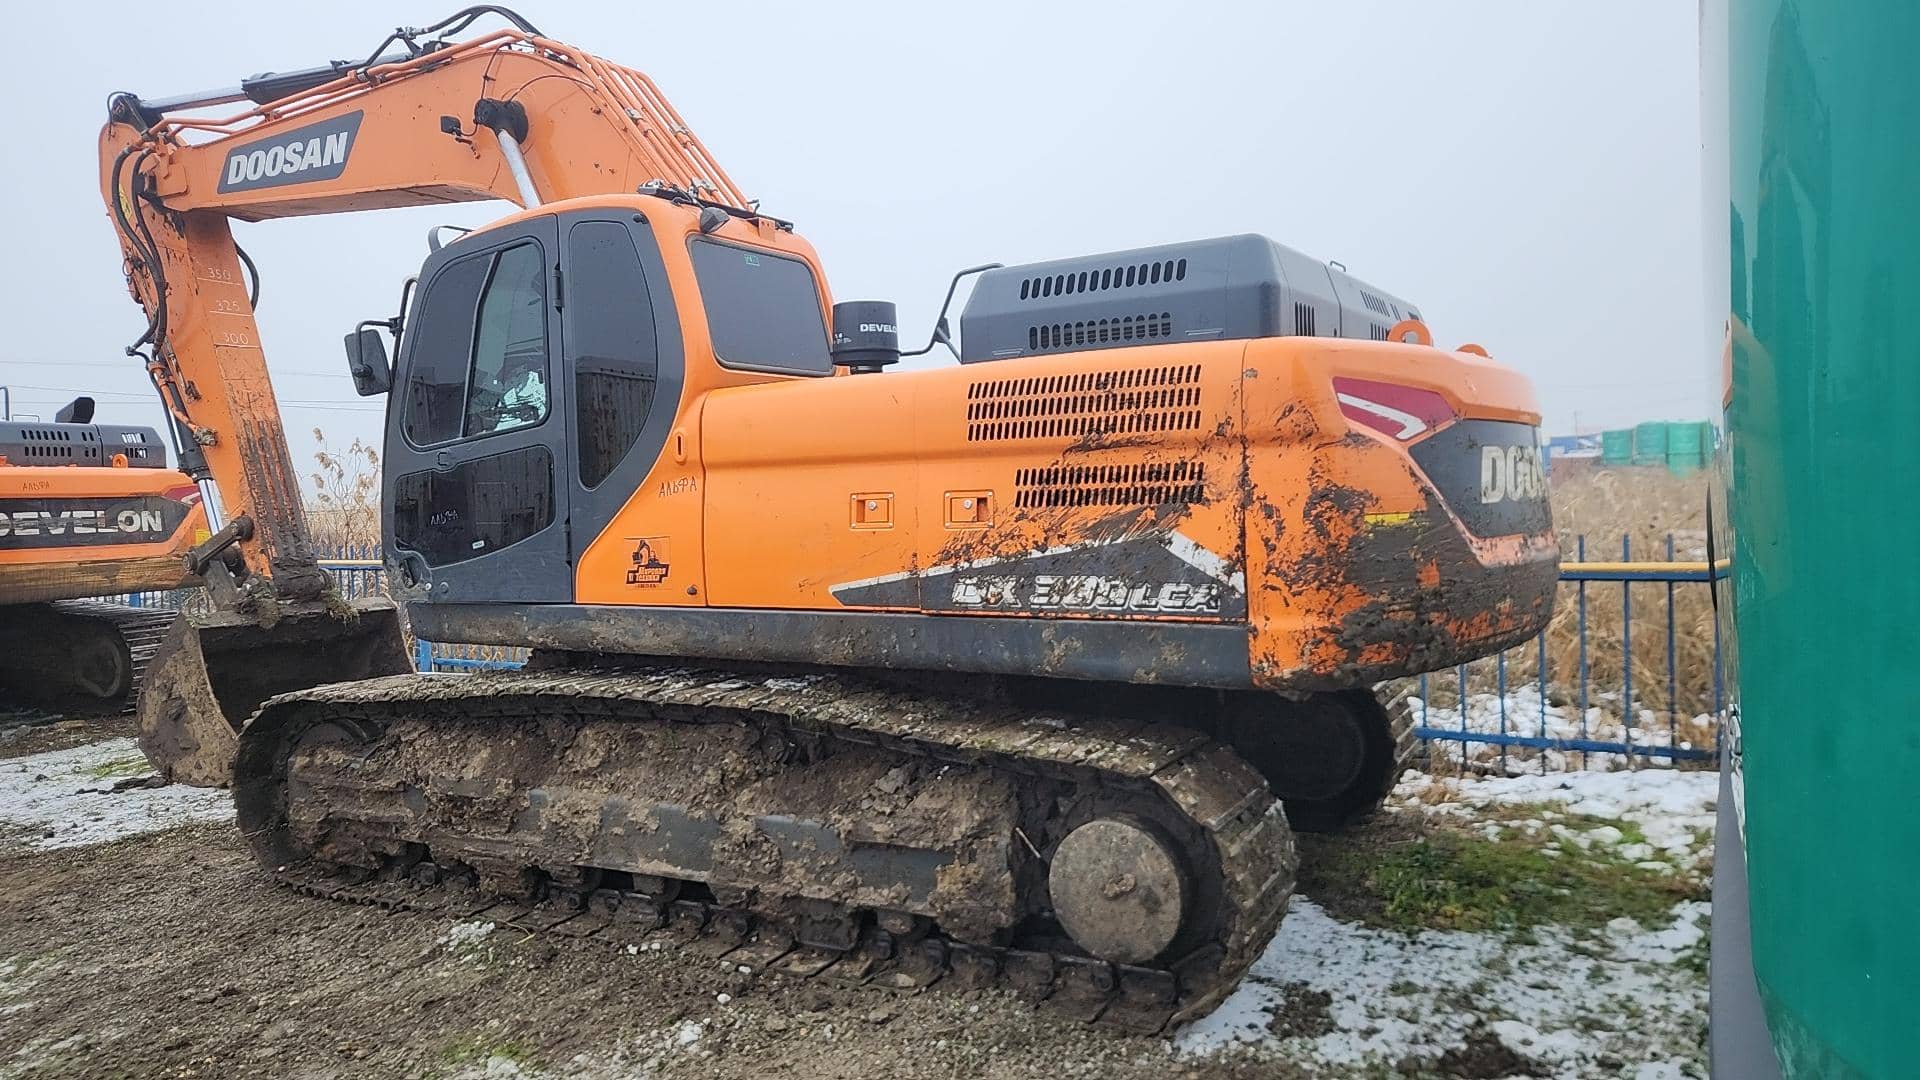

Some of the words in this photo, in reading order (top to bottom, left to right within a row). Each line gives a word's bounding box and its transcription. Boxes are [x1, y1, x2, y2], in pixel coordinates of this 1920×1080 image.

[227, 131, 348, 185] DOOSAN
[207, 267, 231, 280] 350
[216, 300, 240, 312] 325
[223, 332, 249, 345] 300
